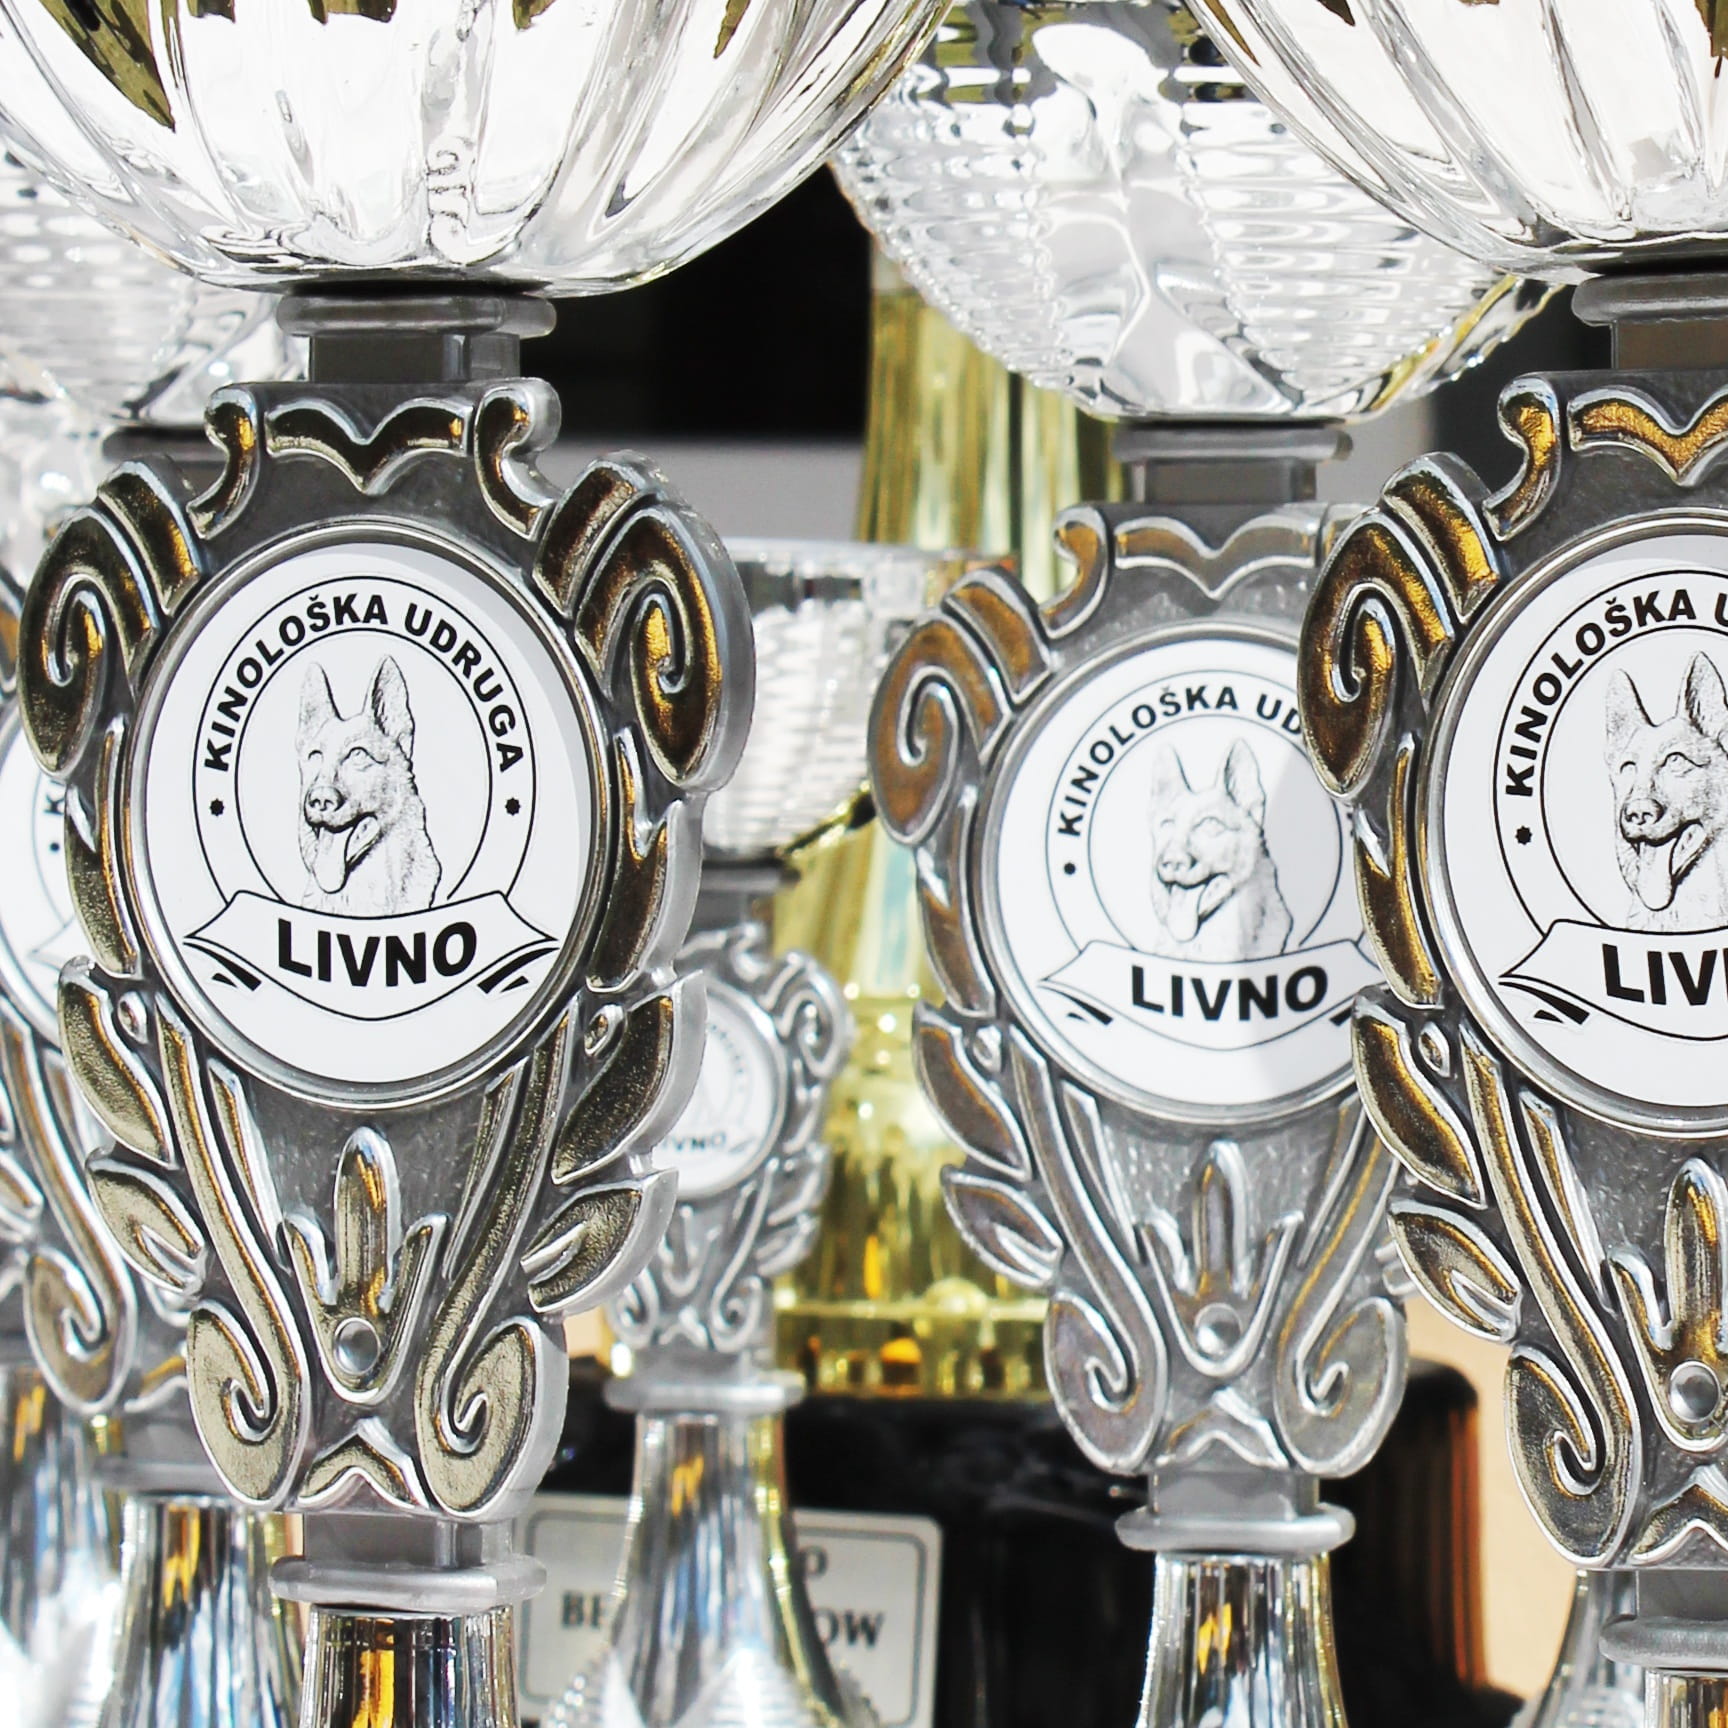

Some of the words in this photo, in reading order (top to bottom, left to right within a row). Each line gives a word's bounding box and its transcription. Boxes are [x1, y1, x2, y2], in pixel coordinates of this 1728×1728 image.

[203, 593, 389, 773] KINOLOŠKA
[403, 607, 527, 774] UDRUGA
[1506, 588, 1697, 798] KINOLOŠKA
[1058, 684, 1239, 837] KINOLOŠKA
[278, 921, 478, 989] LIVNO
[1131, 965, 1328, 1021] LIVNO
[813, 1611, 886, 1648] OW
